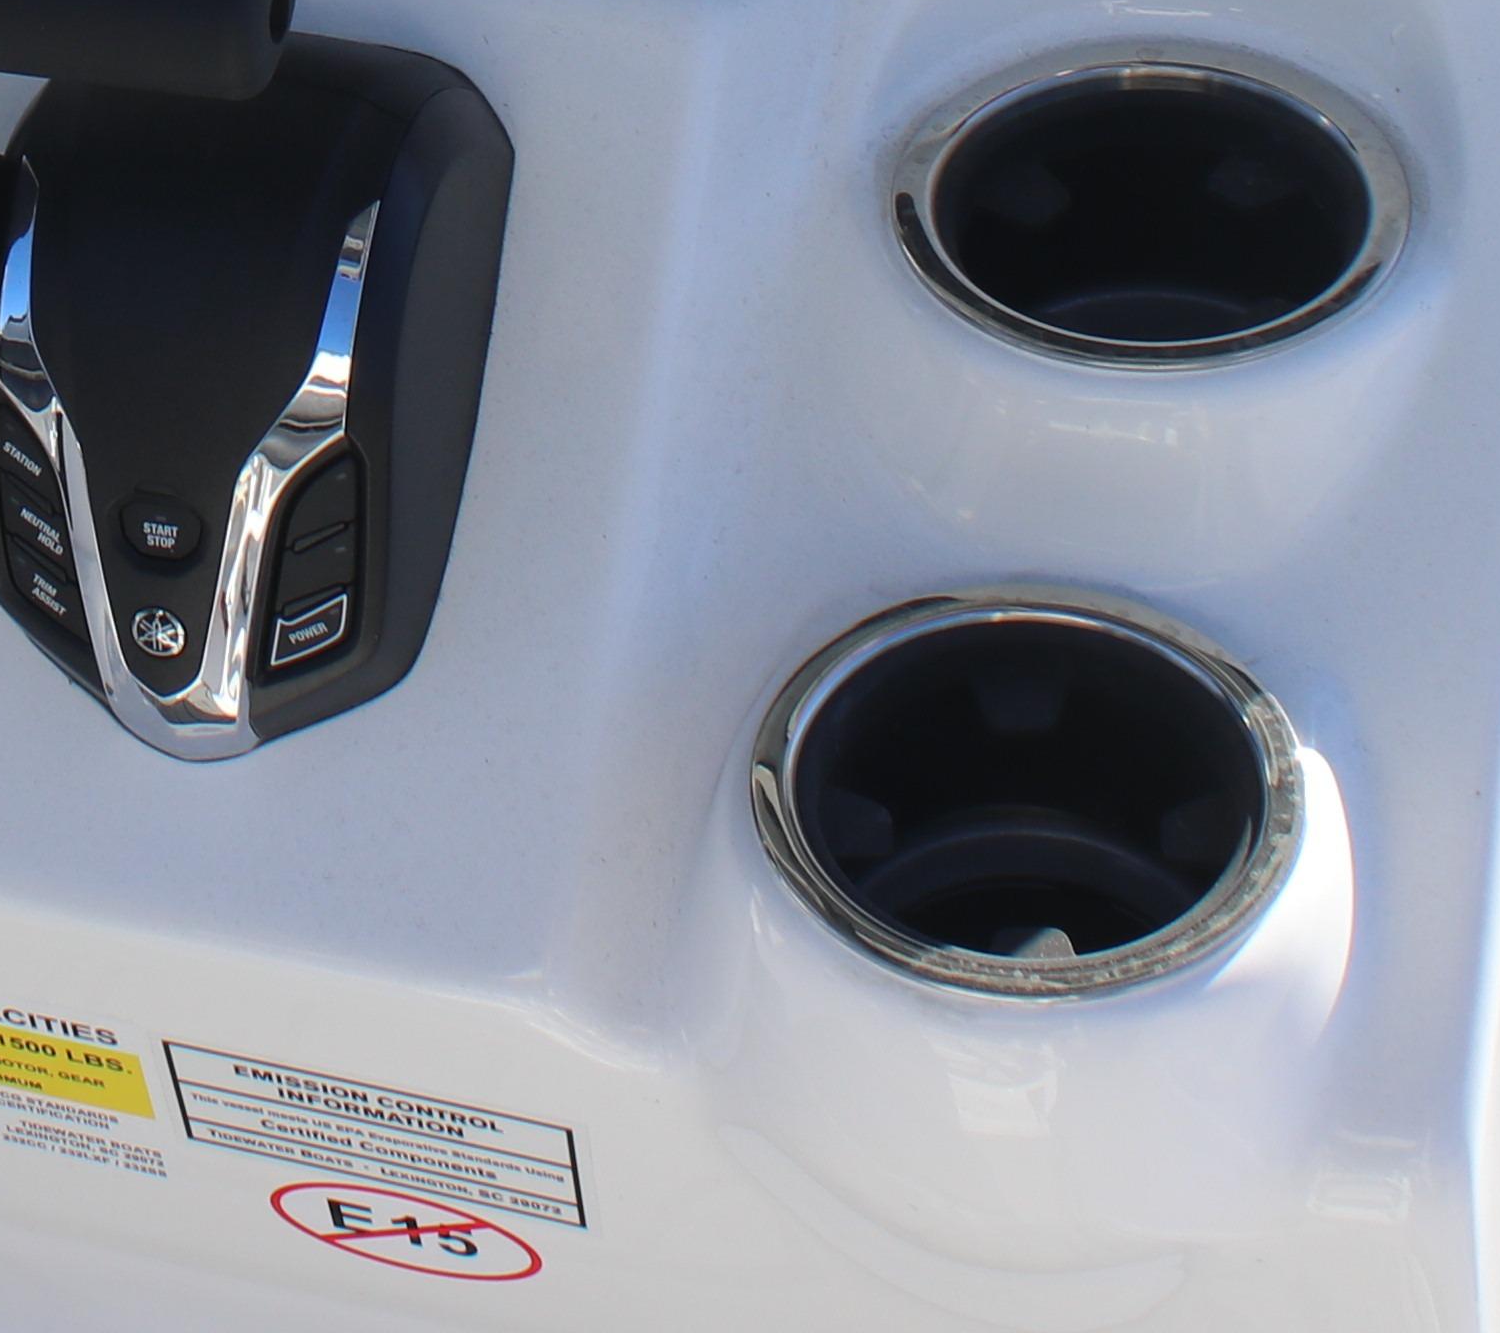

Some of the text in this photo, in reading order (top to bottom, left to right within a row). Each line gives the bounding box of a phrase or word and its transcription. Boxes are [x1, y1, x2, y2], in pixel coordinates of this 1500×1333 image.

[3, 441, 42, 477] STATION
[20, 507, 61, 543] NEUTRAL
[143, 521, 178, 538] START
[37, 532, 63, 556] HOLD
[146, 534, 176, 549] STOP
[32, 573, 58, 598] TRIM
[31, 587, 67, 616] ASSIST
[288, 620, 329, 645] POWER
[66, 1049, 133, 1075] LBS.
[57, 1070, 106, 1089] GEAR
[25, 1096, 120, 1124] STANDARDS
[233, 1063, 505, 1135] EMISSION CONTROL
[277, 1085, 465, 1139] INFORMATION
[19, 1119, 163, 1159] TIDEWATER BOATS
[191, 1091, 566, 1184] This vessel meets US EPA Evaporative Standards Using
[259, 1117, 499, 1181] Certified Components
[207, 1127, 296, 1156] TIDEWATER
[299, 1148, 354, 1168] BOATS
[379, 1166, 475, 1197] LEXINGTON,
[477, 1188, 506, 1202] SC
